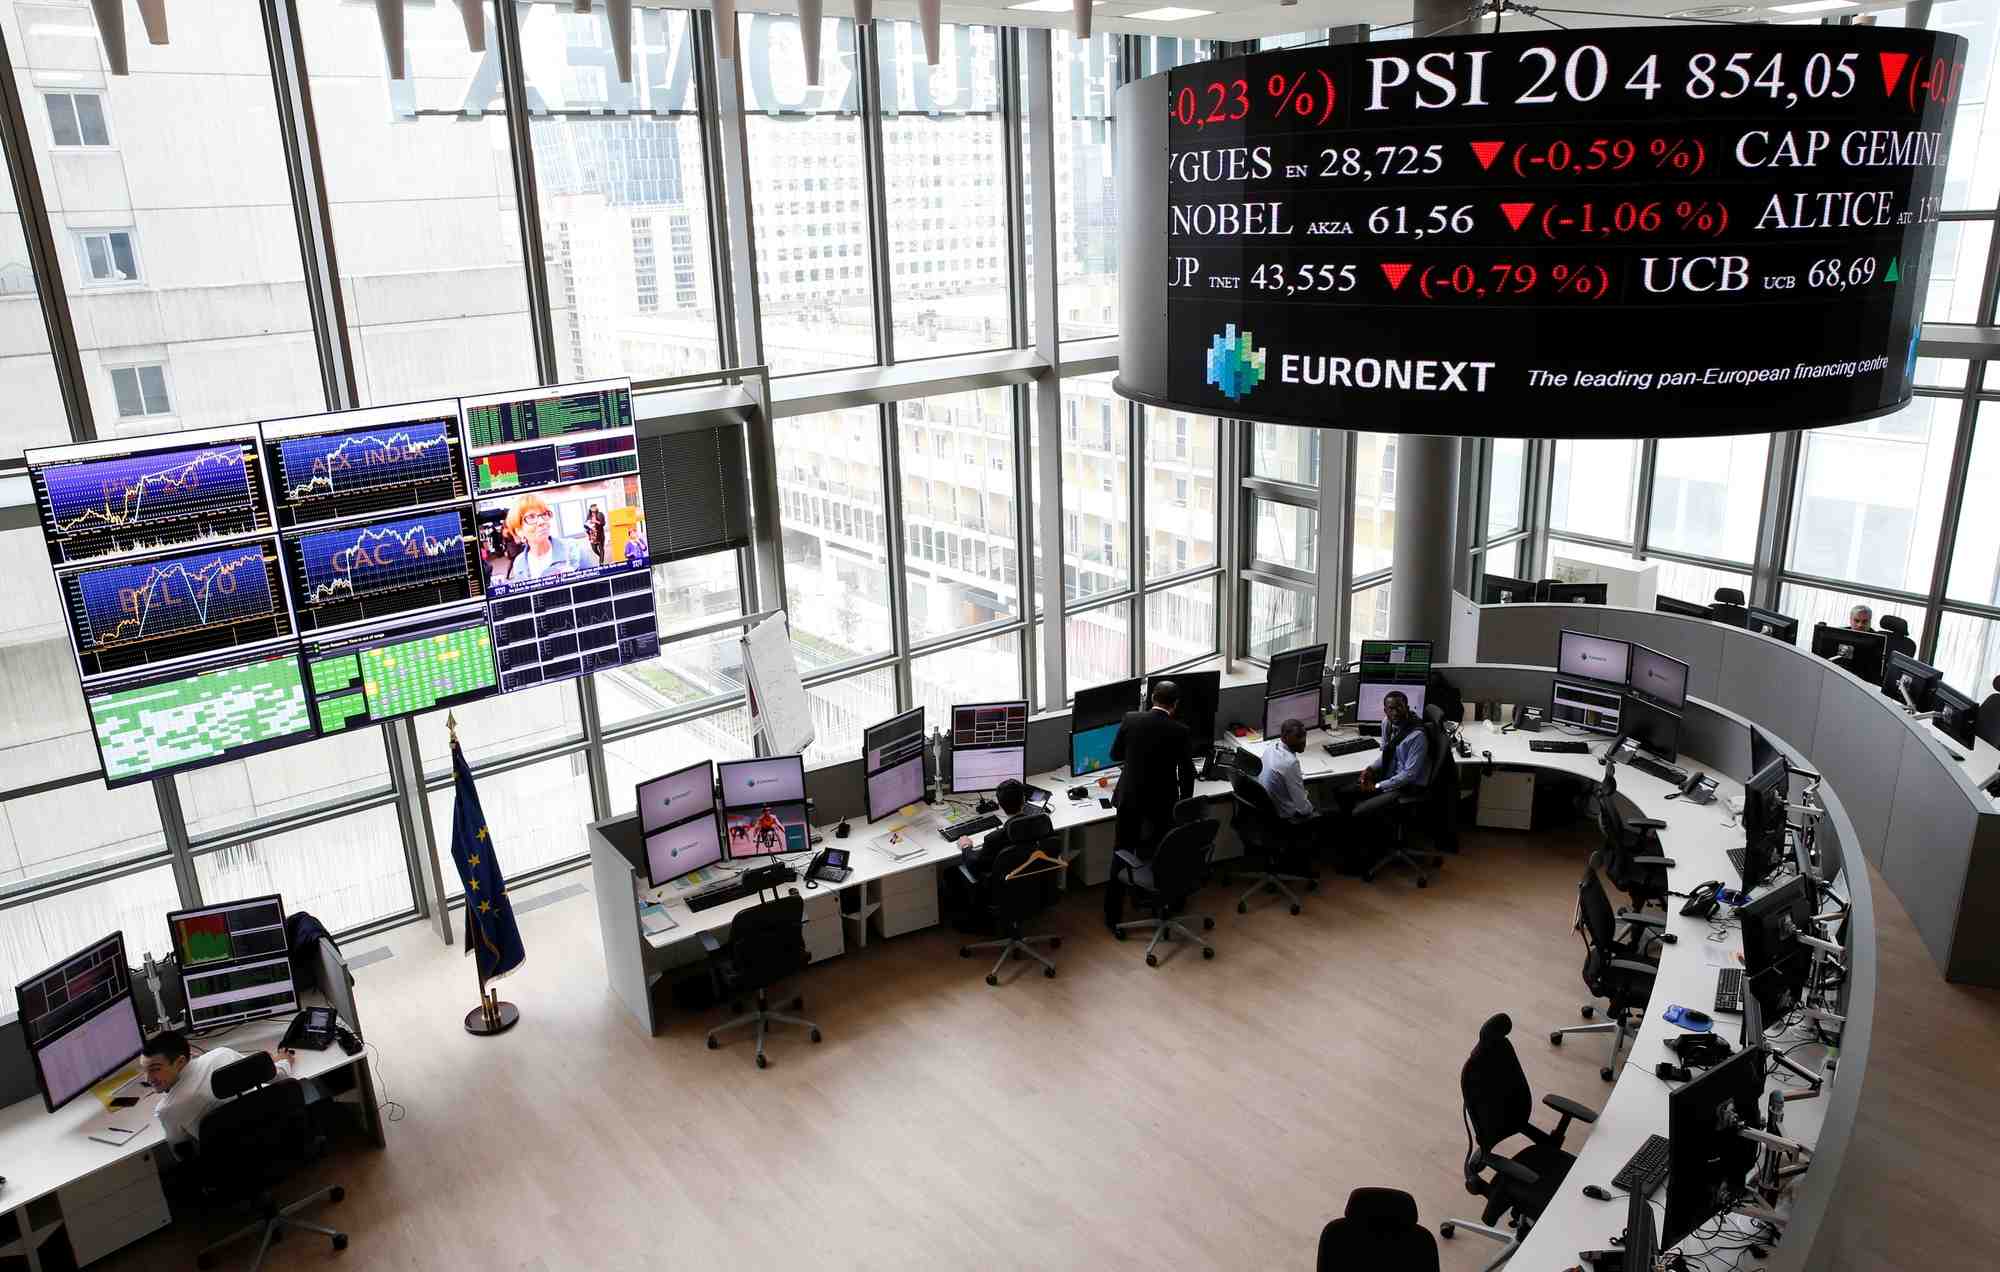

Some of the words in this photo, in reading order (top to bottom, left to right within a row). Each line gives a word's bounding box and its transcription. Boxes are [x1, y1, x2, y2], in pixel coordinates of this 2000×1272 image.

[1268, 71, 1335, 123] %)
[1365, 51, 1490, 110] PSI
[1515, 46, 1607, 103] 20
[1625, 55, 1661, 99] 4
[1686, 53, 1858, 108] 854,05
[1286, 165, 1308, 177] EN
[1320, 145, 1442, 181] 28,725
[1513, 139, 1636, 178] (-0,59
[1651, 139, 1706, 175] %)
[1736, 131, 1829, 167] CAP
[1841, 130, 1942, 167] GEMINI
[1172, 202, 1293, 235] NOBEL
[1307, 222, 1353, 234] AKZA
[1369, 205, 1473, 239] 61,56
[1542, 202, 1661, 239] (-1,06
[1676, 202, 1729, 237] %)
[1755, 192, 1893, 229] ALTICE
[1208, 277, 1240, 289] TNET
[1251, 264, 1356, 296] 43,555
[1419, 264, 1537, 298] (-0,79
[1552, 264, 1609, 299] %)
[1641, 256, 1748, 292] UCB
[1764, 276, 1795, 289] UCB
[1809, 257, 1875, 291] 68,69
[1282, 354, 1495, 392] EURONEXT
[1528, 371, 1567, 386] The
[1574, 370, 1652, 390] leading
[1657, 368, 1790, 389] pan-European
[1793, 361, 1856, 383] financing
[1857, 356, 1889, 372] centre
[331, 543, 396, 574] CAC
